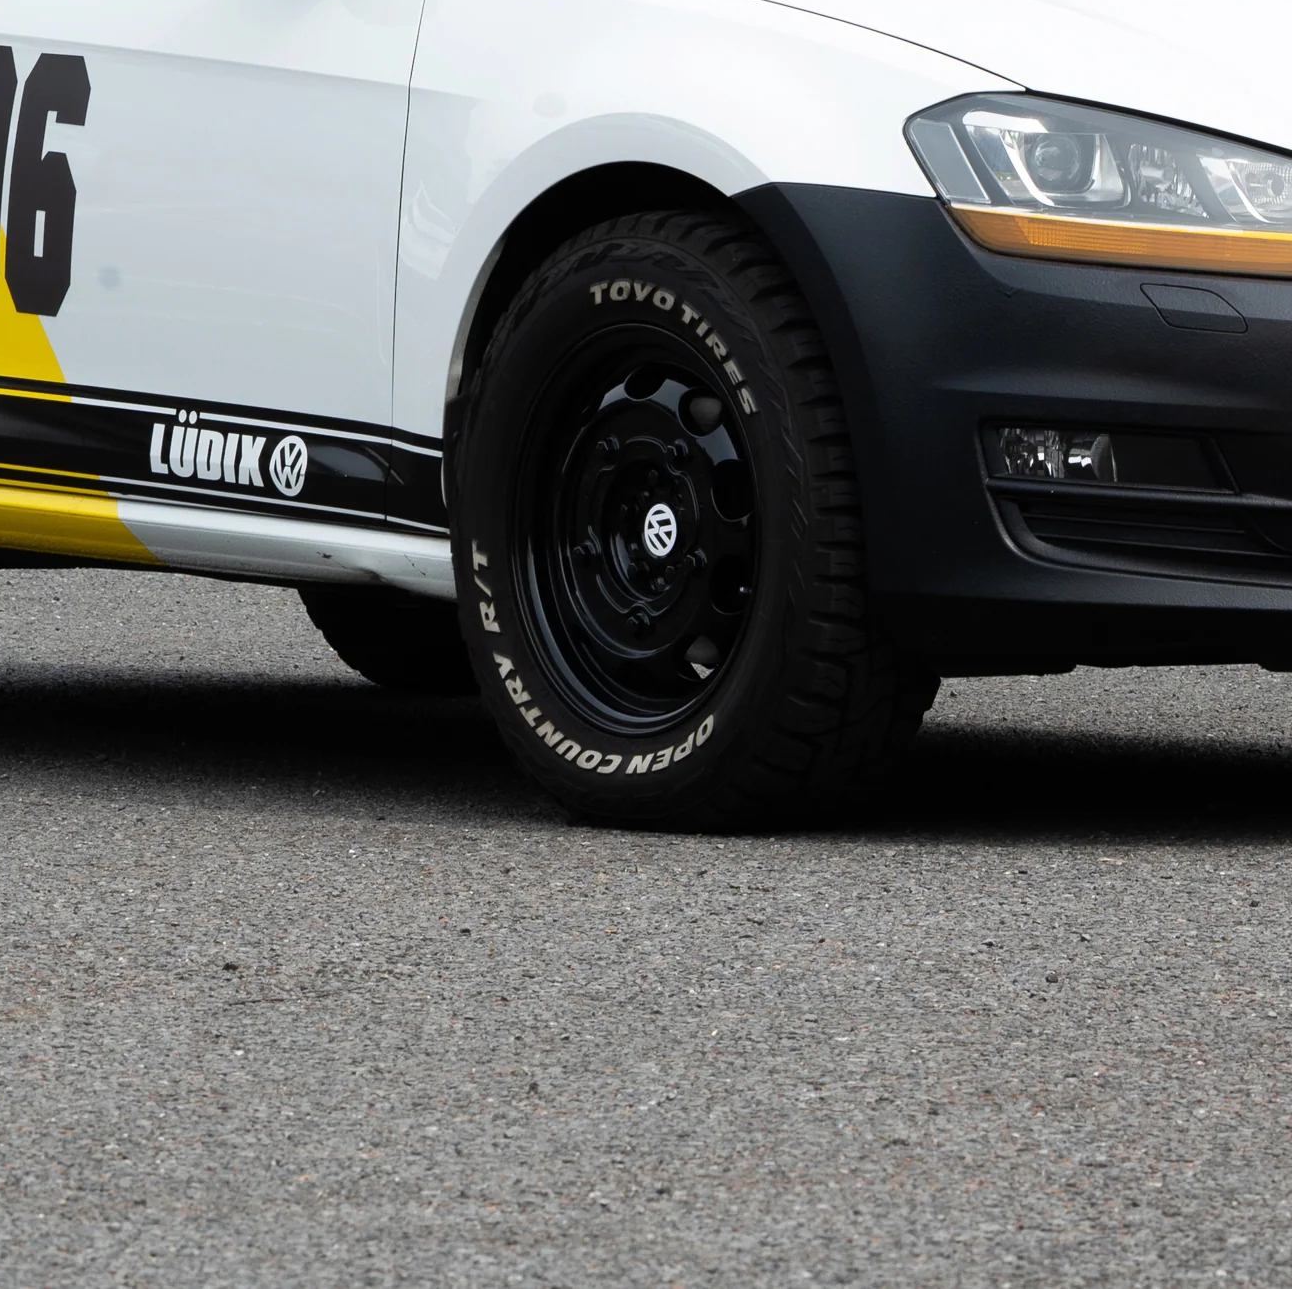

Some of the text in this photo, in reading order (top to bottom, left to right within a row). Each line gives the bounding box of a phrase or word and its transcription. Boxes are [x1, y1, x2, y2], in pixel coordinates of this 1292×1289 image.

[589, 277, 760, 416] TOYO TIRES
[149, 409, 267, 488] LÜDIX
[471, 538, 716, 775] OPEN COUNTRY R/T
